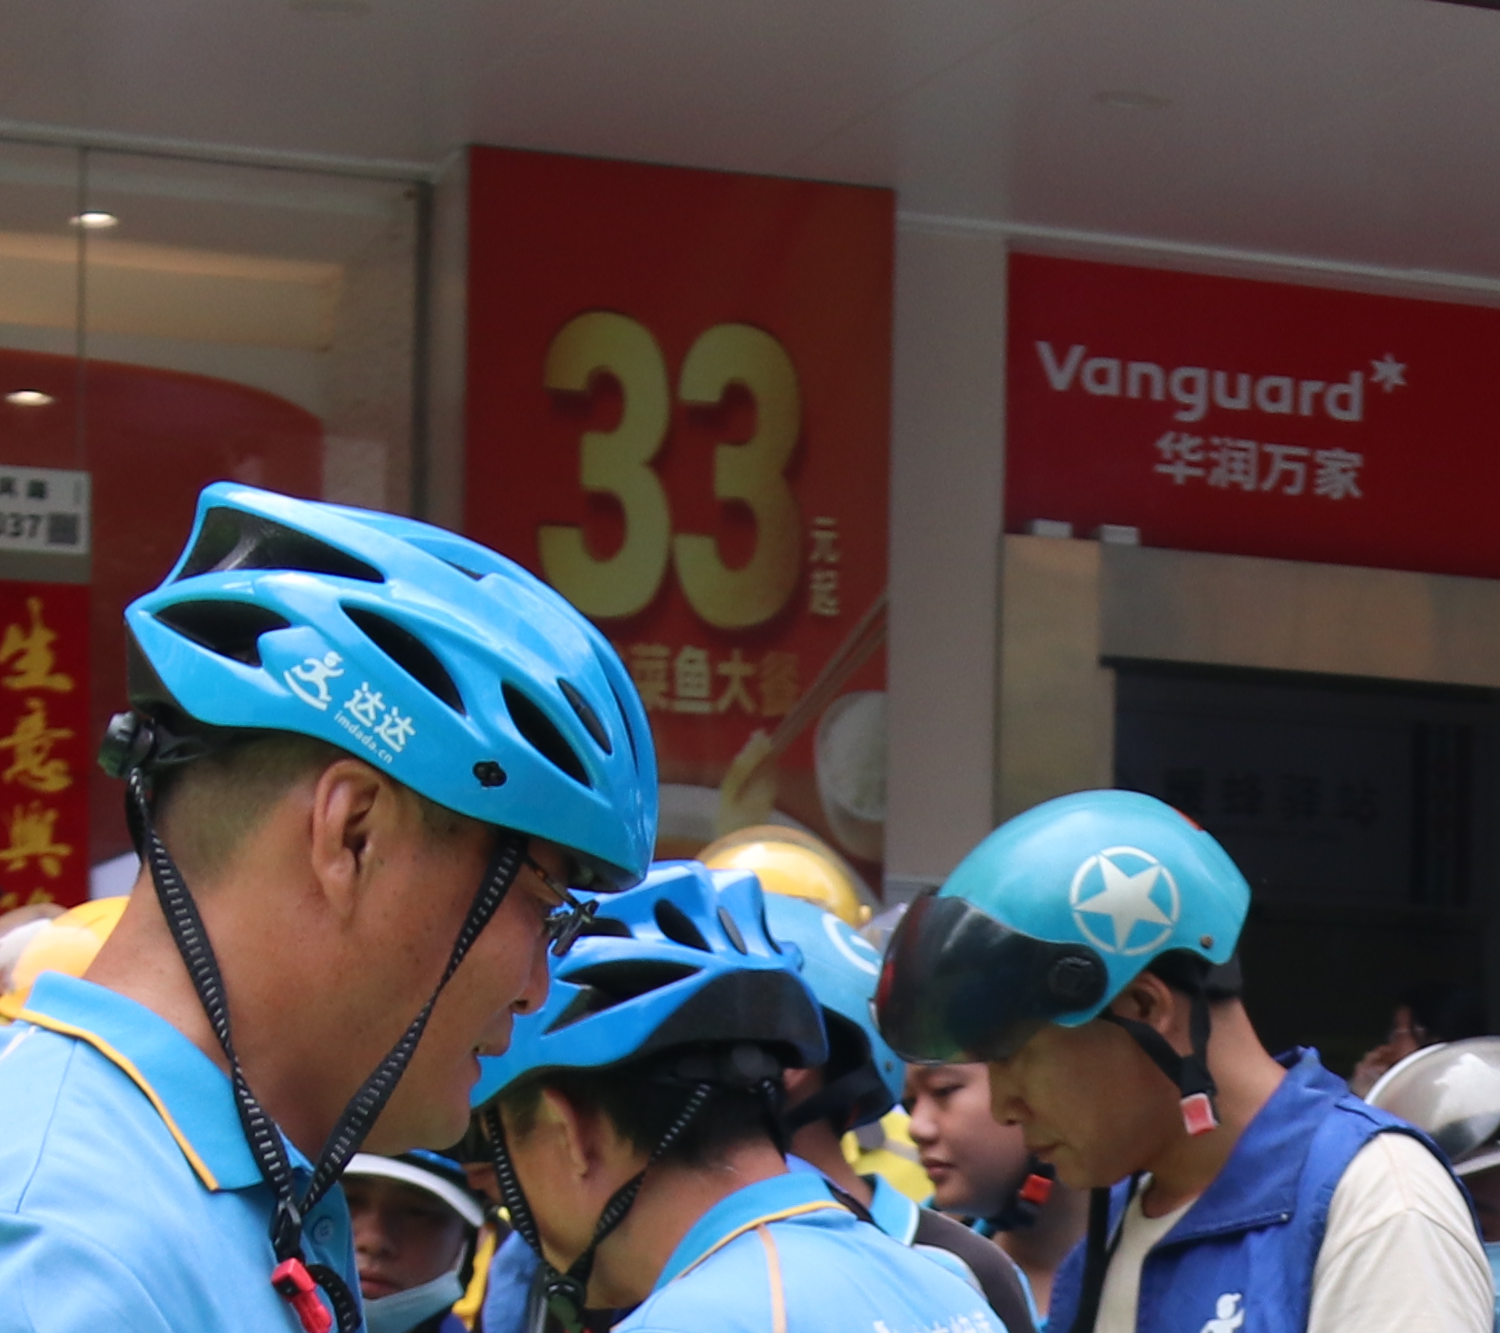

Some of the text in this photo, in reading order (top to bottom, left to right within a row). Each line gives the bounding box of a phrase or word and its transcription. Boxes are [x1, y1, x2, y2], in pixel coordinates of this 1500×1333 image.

[1036, 340, 1364, 422] Vanguard
[537, 312, 803, 630] 33
[1155, 431, 1364, 502] 华润万家
[343, 680, 417, 754] 达达
[612, 641, 803, 718] 菜鱼大餐
[334, 709, 393, 766] imdada.cn
